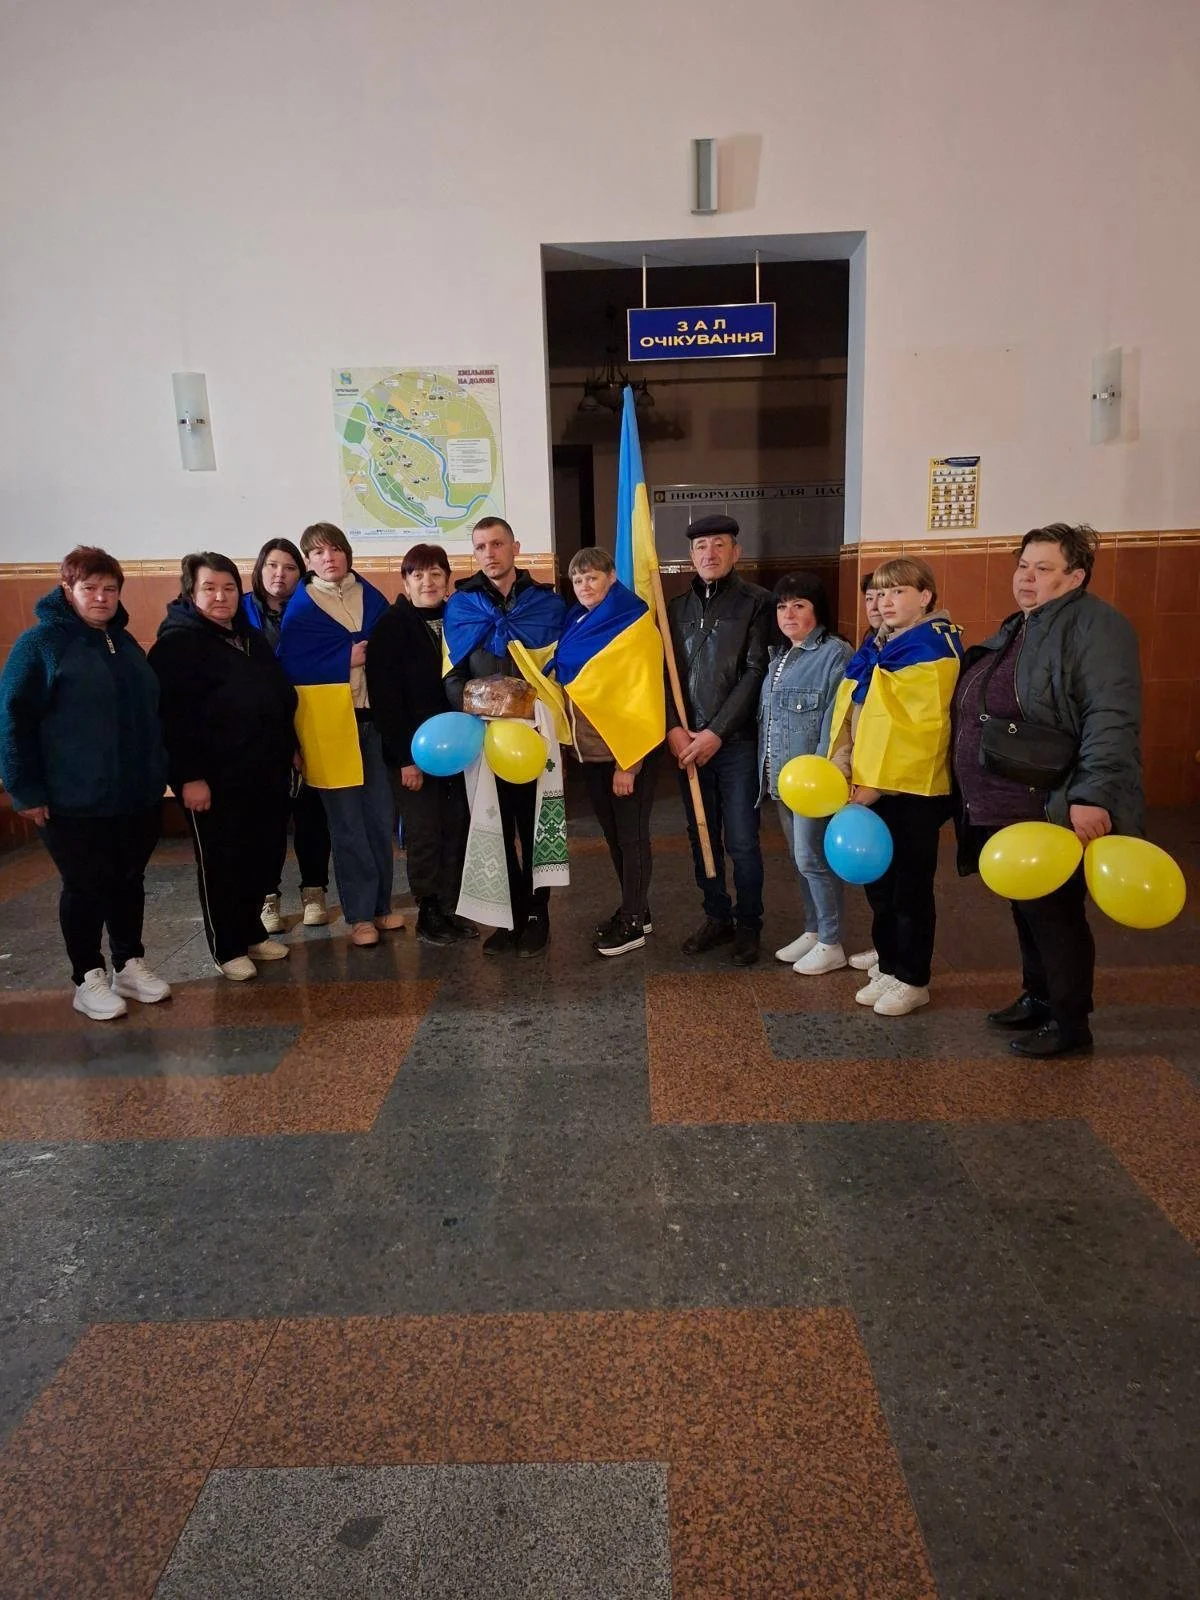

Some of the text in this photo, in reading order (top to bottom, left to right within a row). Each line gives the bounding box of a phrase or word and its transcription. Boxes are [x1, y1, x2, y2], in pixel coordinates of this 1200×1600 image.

[677, 318, 727, 332] ЗАЛ
[639, 331, 764, 348] ОЧІКУВАННЯ
[670, 489, 765, 500] ІНФОРМАЦІЯ
[773, 487, 805, 498] ДЛЯ
